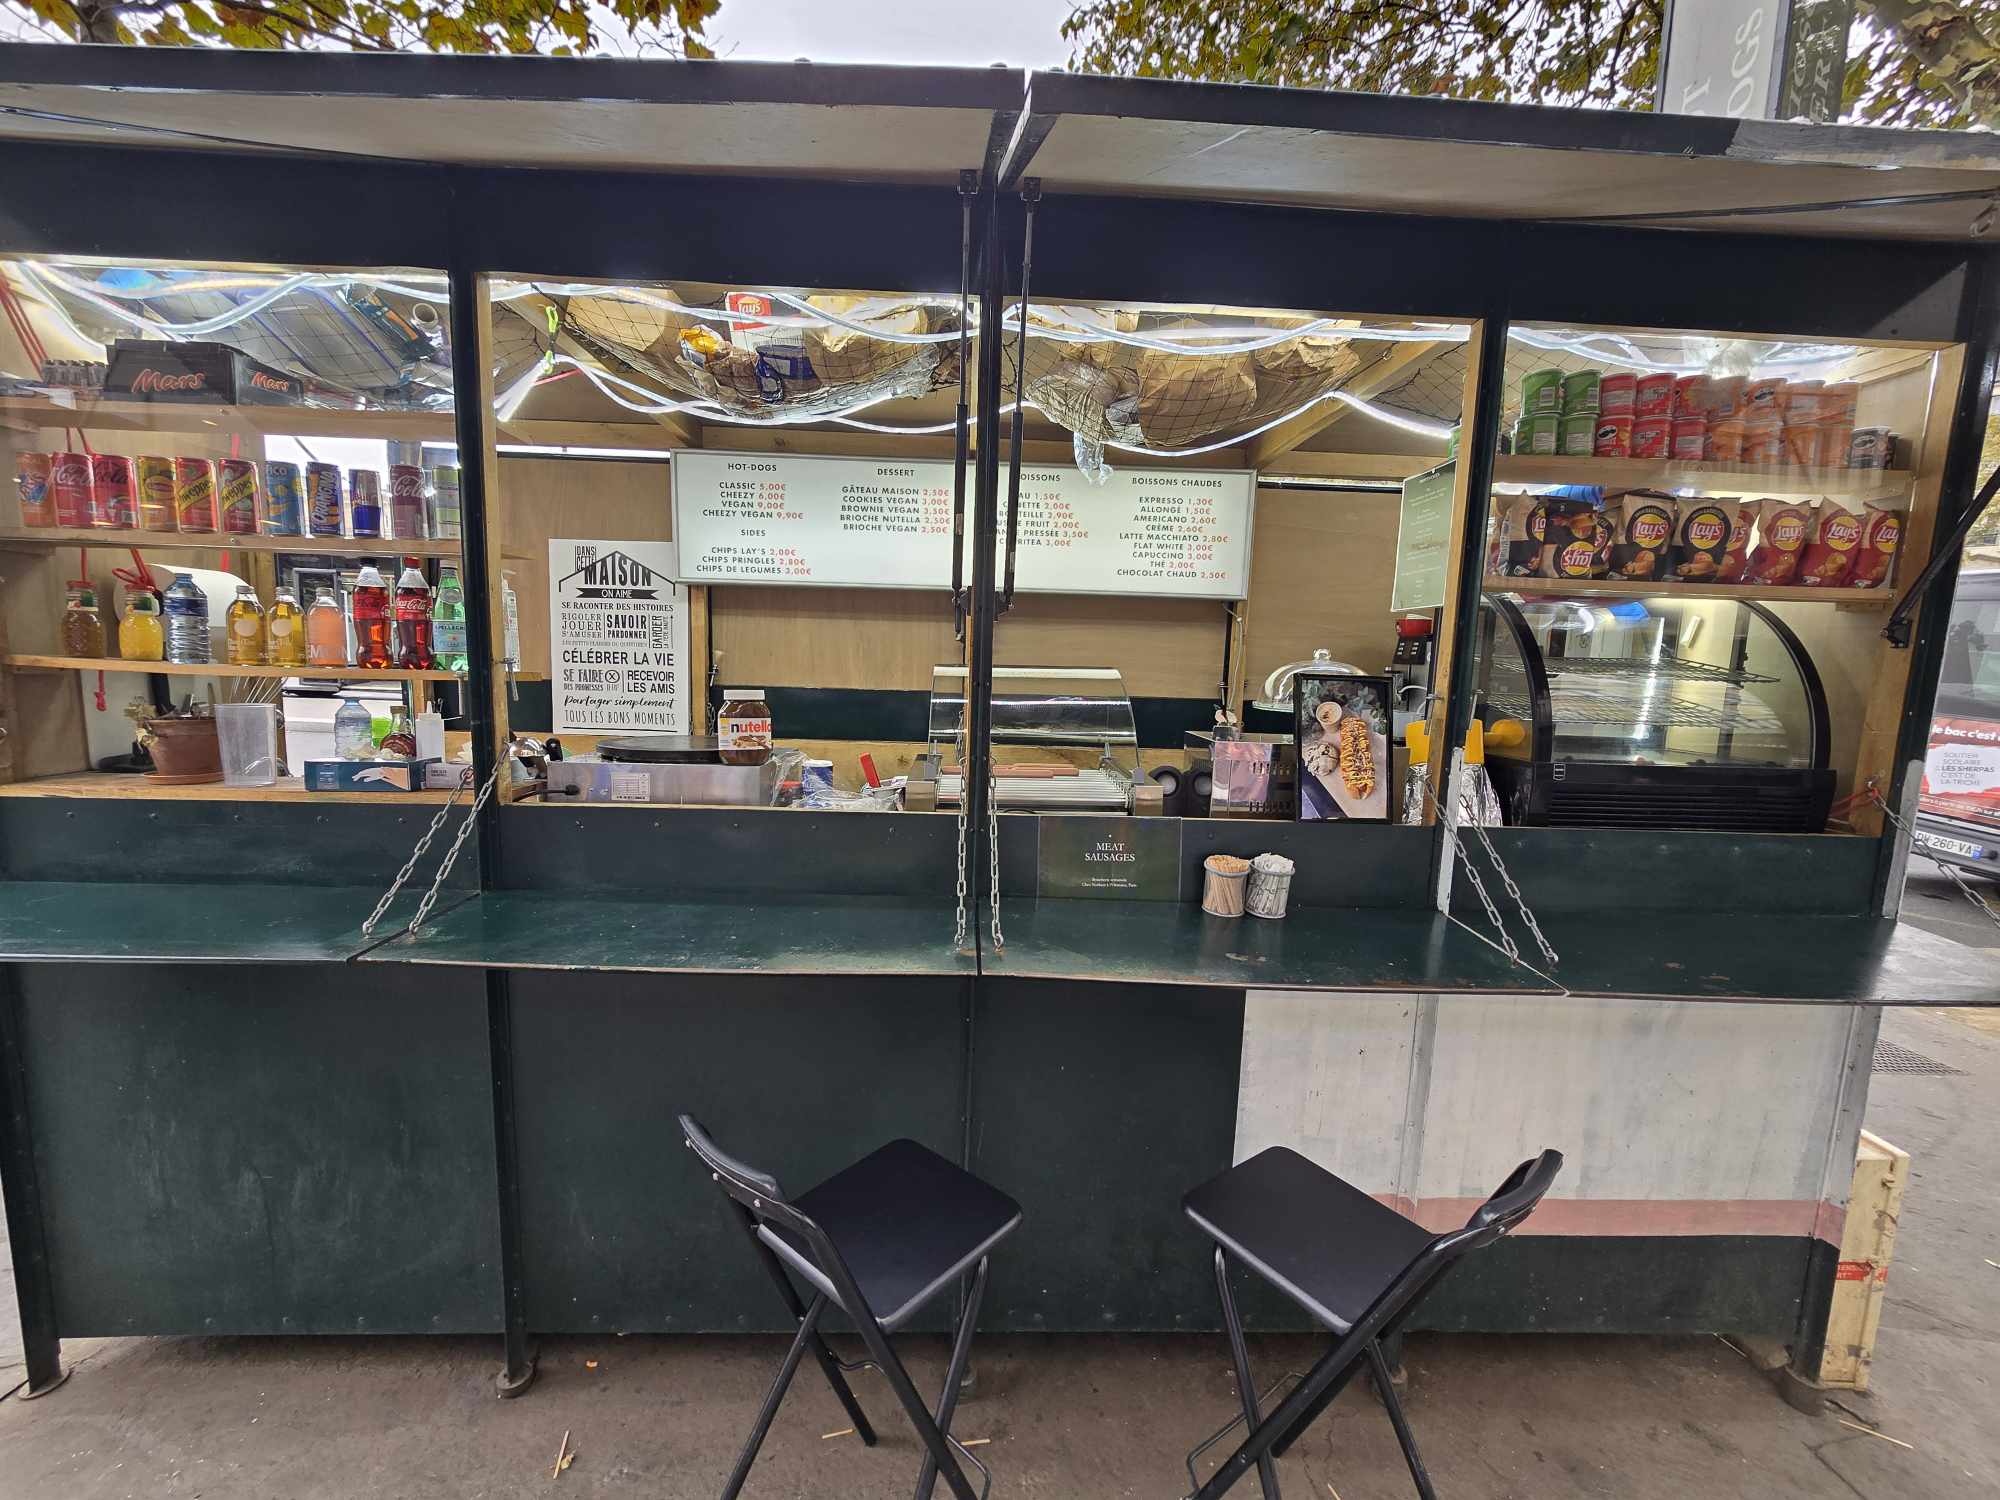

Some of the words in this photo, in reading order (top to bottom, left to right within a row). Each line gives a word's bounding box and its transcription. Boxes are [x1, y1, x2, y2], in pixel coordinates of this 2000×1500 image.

[131, 368, 206, 393] Mars
[251, 371, 289, 392] Mars
[728, 463, 777, 472] HOT-DOGS
[877, 468, 915, 477] DESSERT
[1021, 473, 1061, 482] OISSONS
[1132, 477, 1178, 486] BOISSONS
[1181, 479, 1223, 487] CHAUDES
[719, 482, 756, 490] CLASSIC
[720, 491, 755, 499] CHEEZY
[881, 487, 920, 495] MAISON
[843, 496, 883, 504] COOKIES
[886, 497, 919, 505] VEGAN
[1139, 496, 1184, 505] EXPRESSO
[702, 509, 737, 517] CHEEZY
[841, 505, 884, 513] BROWNIE
[888, 506, 920, 514] VEGAN
[840, 514, 879, 522] BRIOCHE
[1133, 515, 1188, 523] AMERICANO
[741, 529, 767, 537] SIDES
[886, 525, 918, 533] VEGAN
[1023, 529, 1059, 537] PRESSÉE
[1146, 533, 1199, 542] MACCHIATO
[576, 545, 595, 556] DANS
[741, 547, 767, 555] LAY'S
[1133, 542, 1153, 550] FLAT
[1156, 543, 1184, 551] WHITE
[1132, 551, 1184, 560] CAPUCCINO
[732, 557, 776, 565] PRINGLES
[584, 553, 651, 587] MAISON
[740, 566, 782, 574] LEGUMES
[1116, 568, 1164, 577] CHOCOLAT
[1166, 570, 1197, 578] CHAUD
[601, 589, 613, 598] ON
[615, 589, 633, 599] AIME
[561, 601, 571, 609] SE
[573, 601, 614, 611] RACONTER
[616, 602, 631, 611] DES
[633, 603, 674, 612] HISTOIRES
[561, 613, 602, 621] RIGOLER
[561, 621, 602, 631] JOUER
[606, 614, 647, 630] SAVOIR
[607, 630, 647, 640] PARDONNER
[651, 615, 663, 649] GARDER
[562, 647, 629, 665] CÉLÉBRER
[634, 652, 650, 665] LA
[654, 652, 675, 667] VIE
[564, 669, 574, 681] SE
[578, 669, 604, 683] FAIRE
[627, 670, 675, 682] RECEVOIR
[627, 682, 646, 693] LES
[650, 683, 675, 695] AMIS
[614, 695, 678, 710] simplement
[564, 709, 586, 723] TOUS
[590, 710, 604, 724] LES
[607, 711, 631, 725] BONS
[634, 712, 676, 727] MOMENTS
[1944, 726, 1968, 738] bac
[1968, 729, 1997, 741] c'est
[1957, 765, 1995, 773] SHERPAS
[1096, 842, 1125, 852] MEAT
[1084, 852, 1136, 862] SAUSAGES
